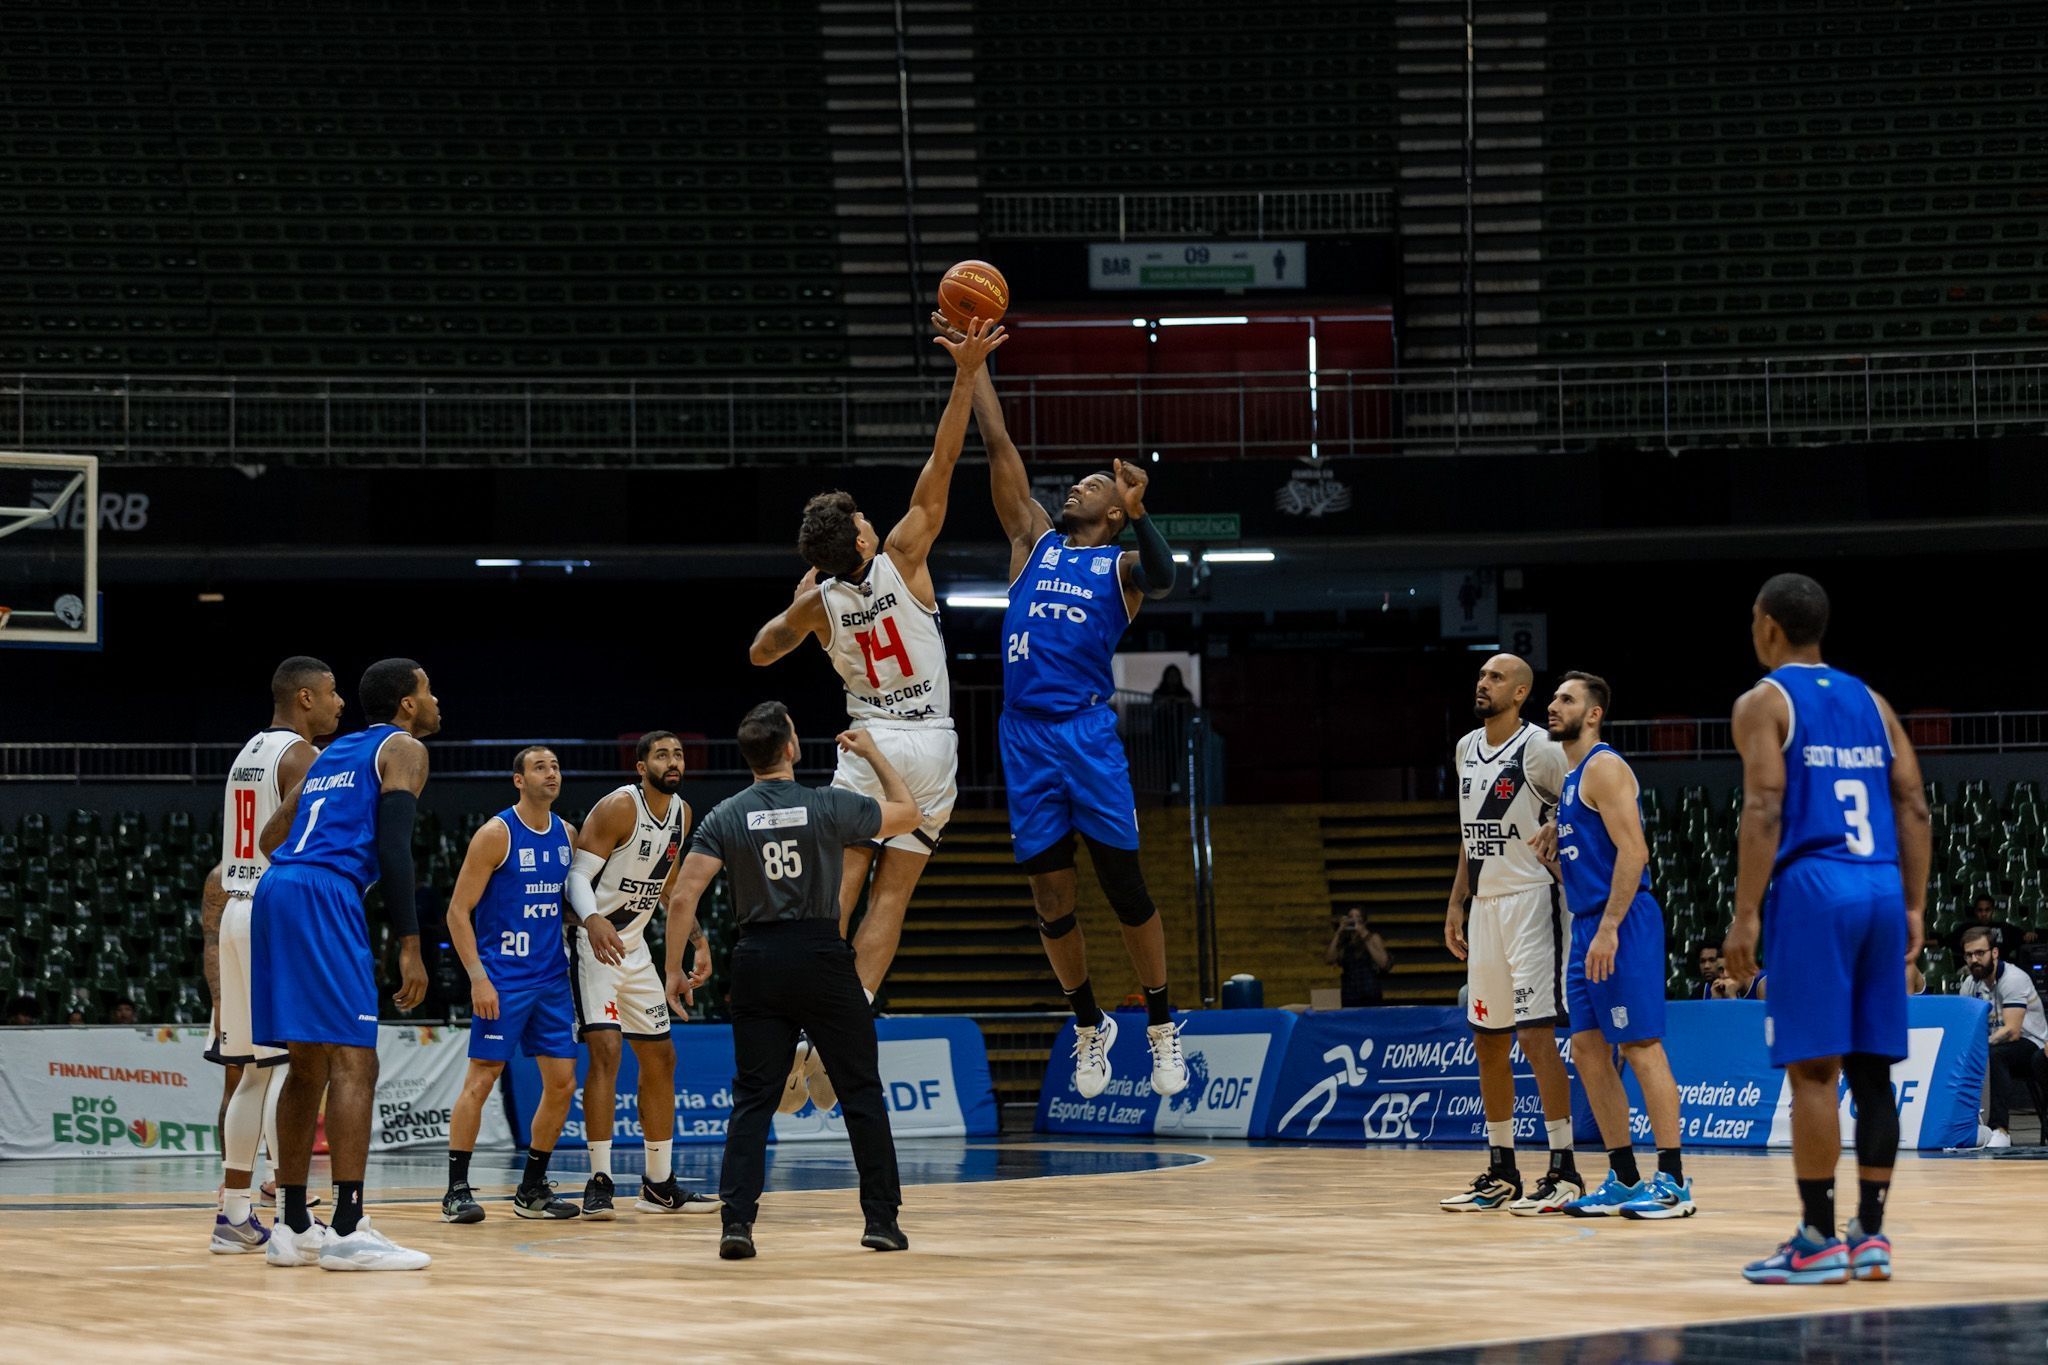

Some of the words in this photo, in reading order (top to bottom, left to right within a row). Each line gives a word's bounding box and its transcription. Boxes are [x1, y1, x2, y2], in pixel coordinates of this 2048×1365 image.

[1184, 247, 1211, 264] 09
[951, 270, 1006, 305] PENALTY
[1035, 577, 1093, 600] minas
[1028, 602, 1087, 624] KTO
[854, 615, 914, 689] 14
[1008, 631, 1029, 664] 24
[1513, 630, 1532, 655] 8
[884, 679, 932, 706] SCORE
[302, 770, 356, 795] HOLLOWELL
[235, 789, 256, 859] 19
[293, 797, 326, 854] 1
[1833, 779, 1875, 857] 3
[1463, 823, 1521, 840] STRELA
[762, 840, 803, 880] 85
[1477, 841, 1507, 856] BET
[618, 877, 663, 896] ESTRE
[523, 903, 558, 918] KTO
[500, 931, 530, 957] 20
[1382, 1037, 1476, 1073] FORMAÇÃO
[48, 1062, 188, 1088] FINANCIAMENTO:
[72, 1096, 117, 1115] pró
[885, 1080, 940, 1113] DF
[1208, 1077, 1253, 1111] GDF
[1447, 1096, 1486, 1116] COMI
[1737, 1081, 1761, 1107] de
[379, 1101, 411, 1118] RIO
[1048, 1097, 1096, 1123] Esporte
[1098, 1106, 1107, 1122] e
[1108, 1102, 1146, 1125] Lazer
[53, 1112, 222, 1152] ESPORT
[381, 1129, 409, 1145] DO
[412, 1125, 449, 1140] SUL
[1470, 1122, 1482, 1135] DE
[1688, 1118, 1700, 1137] e
[1702, 1113, 1754, 1139] Lazer
